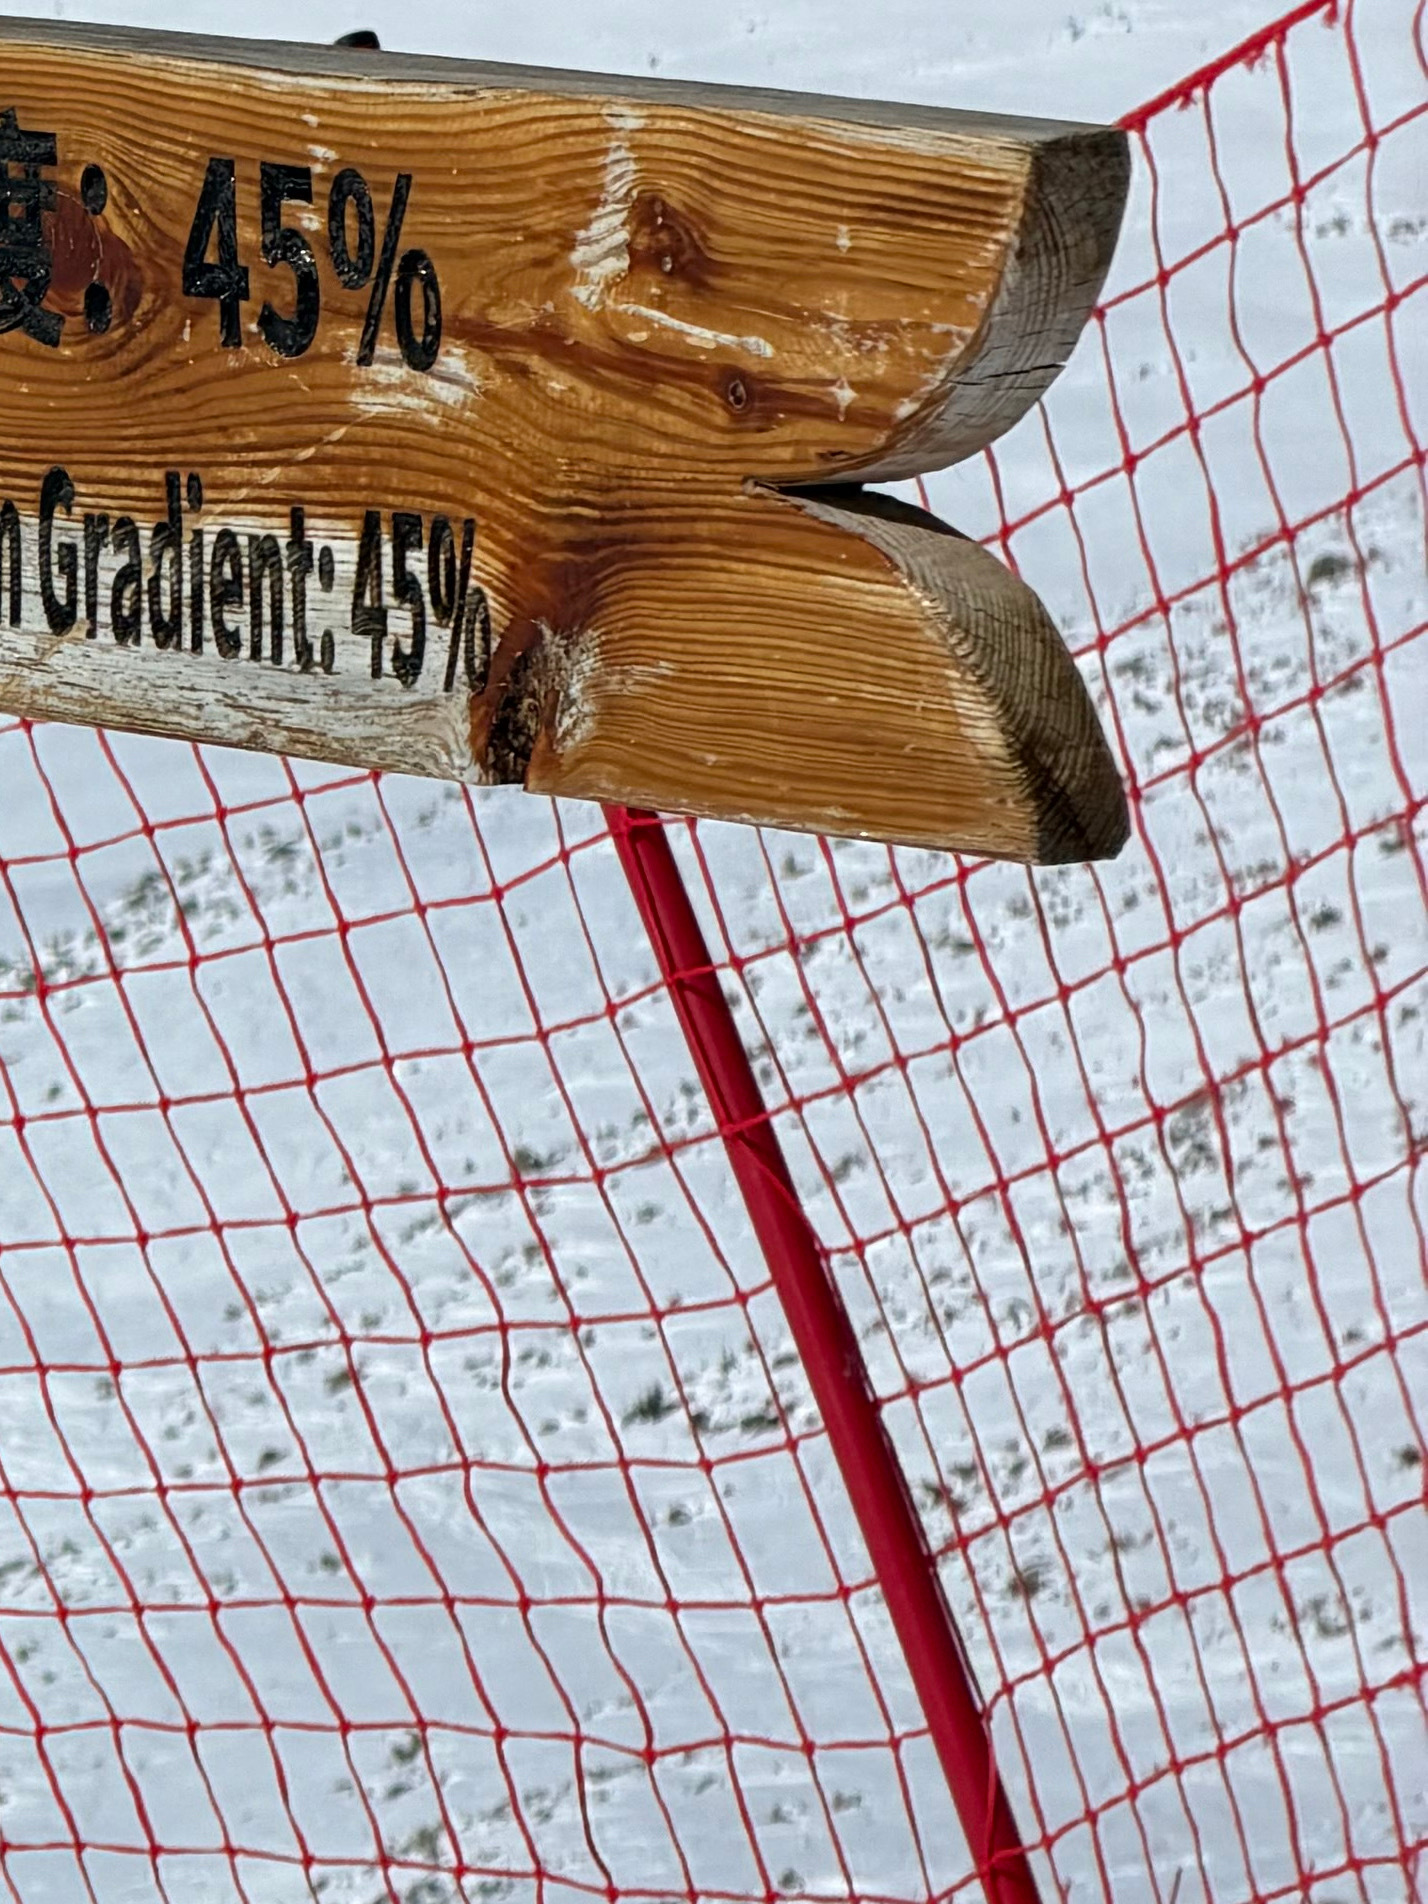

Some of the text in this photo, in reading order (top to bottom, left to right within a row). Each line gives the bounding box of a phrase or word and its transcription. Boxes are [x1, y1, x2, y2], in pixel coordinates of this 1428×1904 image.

[182, 157, 442, 372] 45%
[38, 466, 338, 674] Gradient:
[353, 510, 492, 696] 45%
